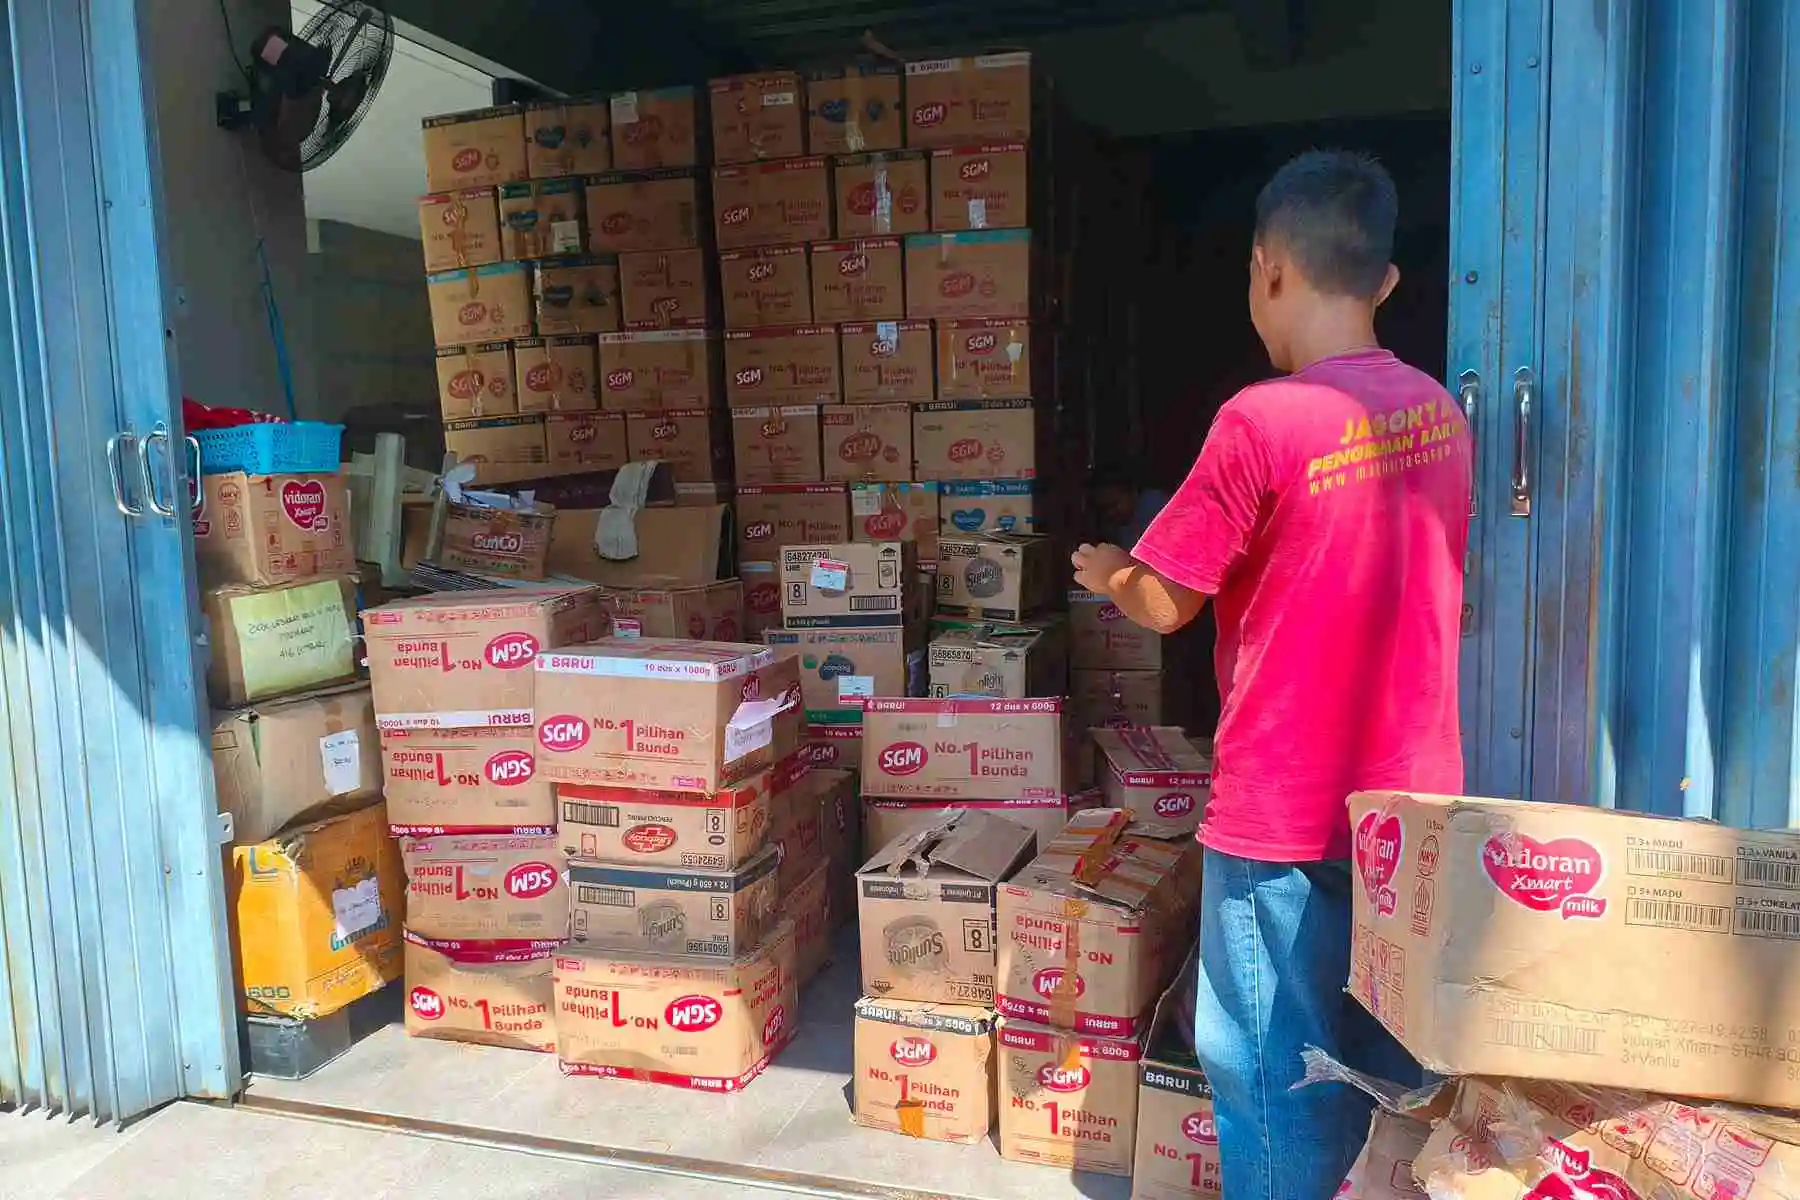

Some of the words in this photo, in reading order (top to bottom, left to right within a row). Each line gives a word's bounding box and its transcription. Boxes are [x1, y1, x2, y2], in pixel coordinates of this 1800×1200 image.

[916, 105, 943, 124] SGM
[793, 584, 801, 598] 8
[398, 642, 439, 653] Bunda
[492, 640, 533, 663] SGM
[457, 659, 482, 670] No.
[551, 655, 594, 669] BARU!
[488, 712, 531, 725] BARU!
[543, 721, 583, 742] SGM
[593, 717, 618, 730] No.
[620, 719, 633, 751] 1
[636, 726, 685, 740] Pilihan
[636, 742, 679, 755] Bunda
[981, 748, 1033, 760] Pilihan
[393, 753, 433, 763] Bunda
[883, 747, 921, 768] SGM
[935, 742, 961, 754] No.
[963, 742, 978, 775] 1
[436, 753, 451, 786] 1
[492, 758, 532, 780] SGM
[981, 765, 1028, 777] Bunda
[454, 772, 480, 786] No.
[1157, 797, 1190, 813] SGM
[1652, 840, 1683, 849] MADU
[413, 866, 452, 878] Bunda
[456, 866, 471, 900] 1
[511, 869, 554, 893] SGM
[1511, 875, 1573, 890] Xmart
[473, 887, 498, 899] No.
[1652, 889, 1683, 899] MADU
[1567, 900, 1600, 913] milk
[1016, 914, 1062, 932] Bunda
[972, 929, 982, 948] 8
[887, 932, 943, 966] Sunlight
[1084, 950, 1113, 965] No.
[566, 987, 608, 1000] Bunda
[412, 992, 440, 1012] SGM
[448, 996, 473, 1009] No.
[474, 1000, 491, 1030] 1
[493, 1002, 547, 1016] Pilihan
[562, 1003, 608, 1018] Pilihan
[612, 991, 628, 1027] 1
[673, 1004, 716, 1026] SGM
[495, 1018, 543, 1031] Bunda
[630, 1016, 658, 1030] No.
[1004, 1034, 1035, 1046] BARU!
[895, 1041, 930, 1059] SGM
[869, 1067, 893, 1082] No.
[1041, 1066, 1084, 1085] SGM
[1145, 1071, 1190, 1091] BARU!
[911, 1082, 960, 1098] Pilihan
[1012, 1096, 1040, 1111] No.
[1042, 1101, 1059, 1135] 1
[1062, 1108, 1118, 1128] Pilihan
[1062, 1126, 1112, 1143] Bunda
[1154, 1143, 1182, 1160] No.
[1186, 1153, 1201, 1187] 1
